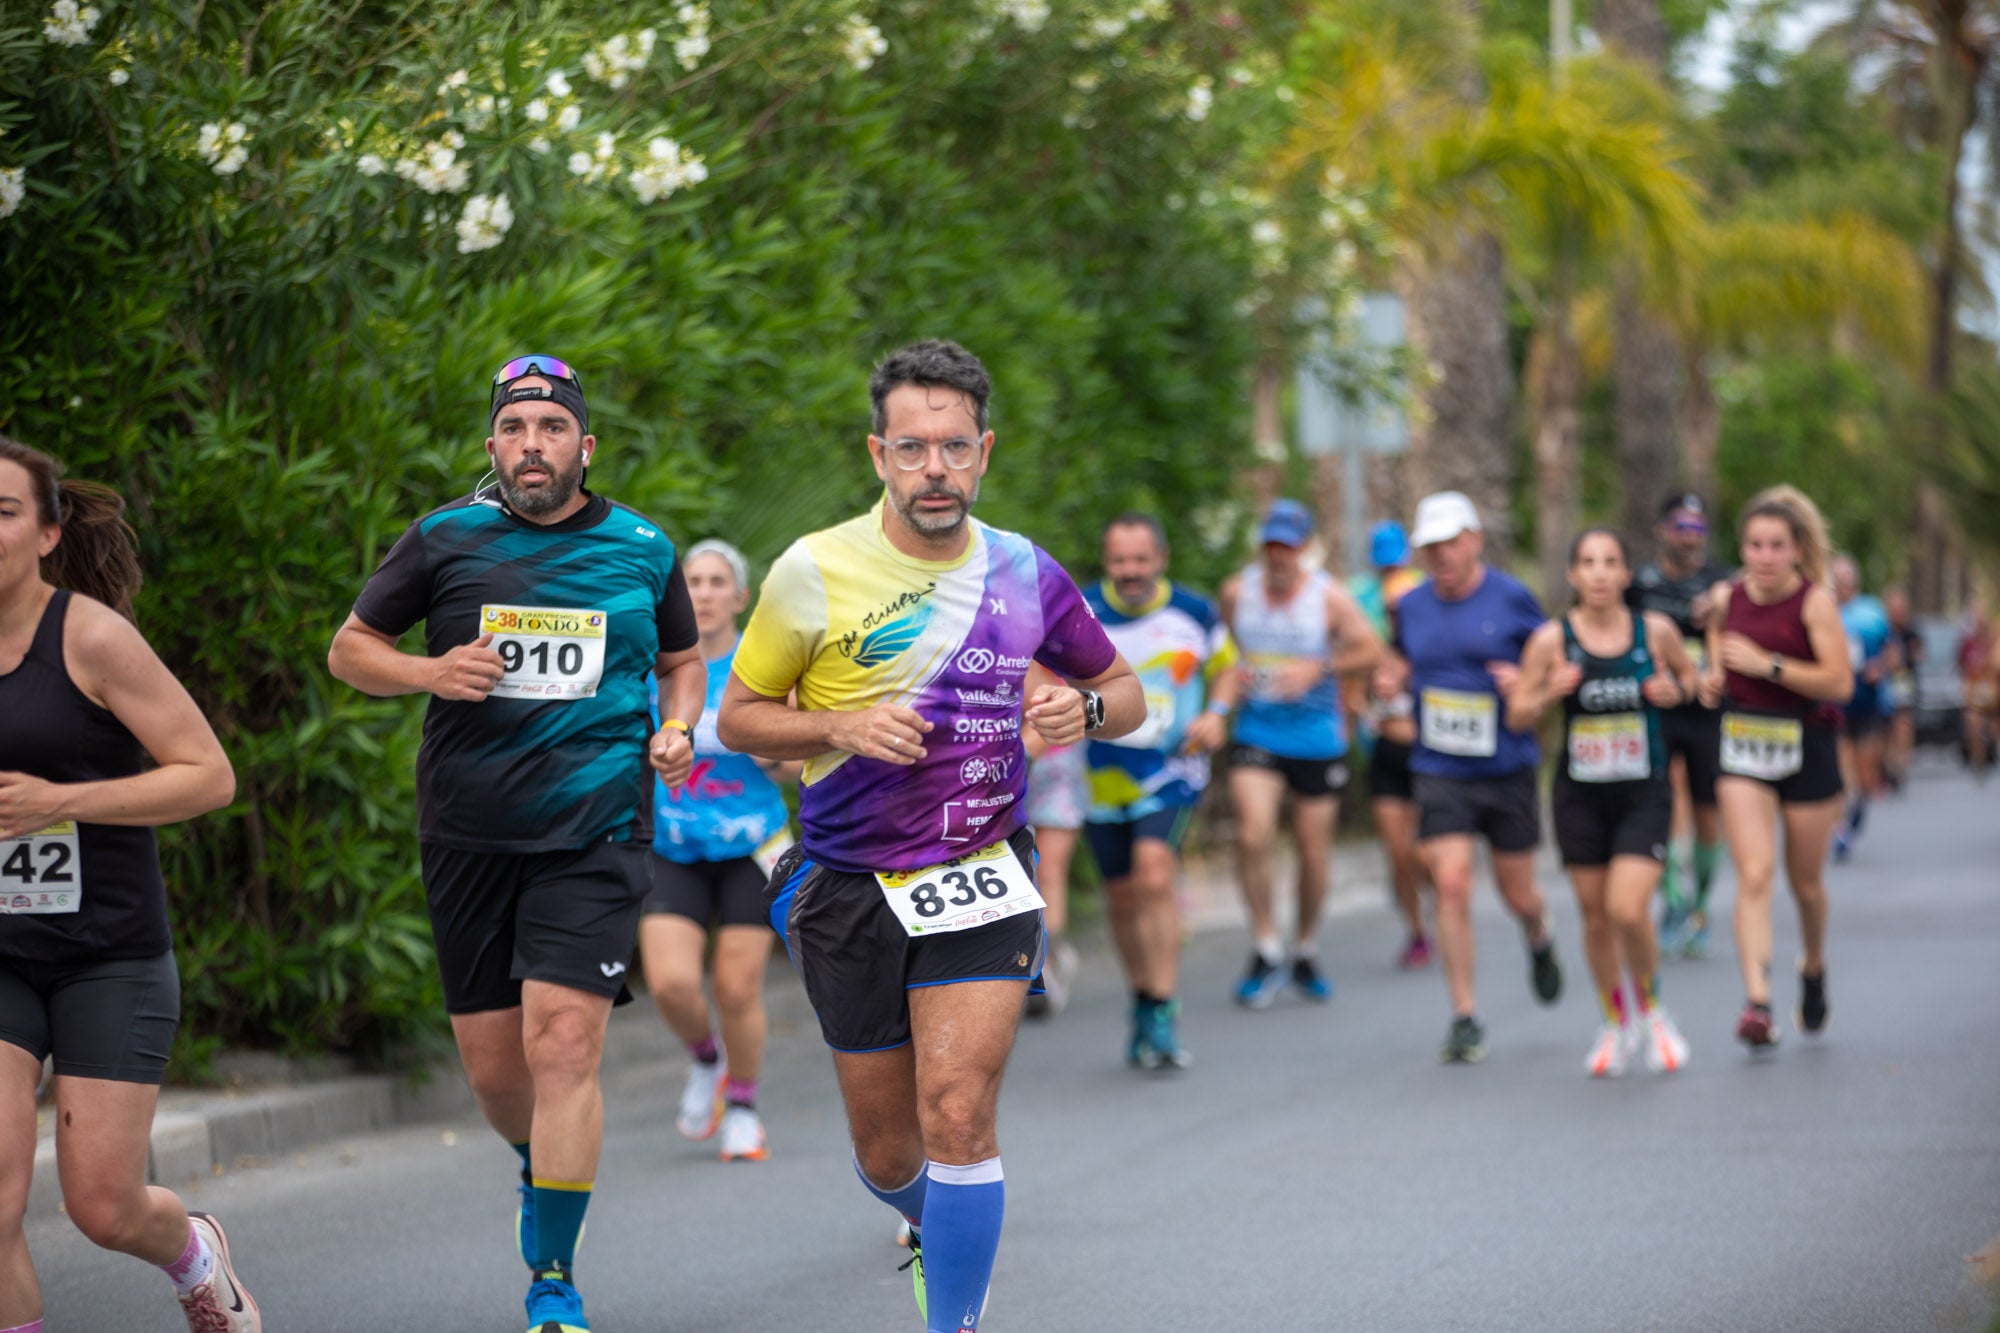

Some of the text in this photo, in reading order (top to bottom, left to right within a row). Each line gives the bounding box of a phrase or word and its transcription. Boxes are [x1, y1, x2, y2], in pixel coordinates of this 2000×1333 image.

[498, 612, 517, 627] 38
[518, 618, 579, 632] FONDO
[498, 640, 583, 676] 910
[910, 866, 1008, 918] 836
